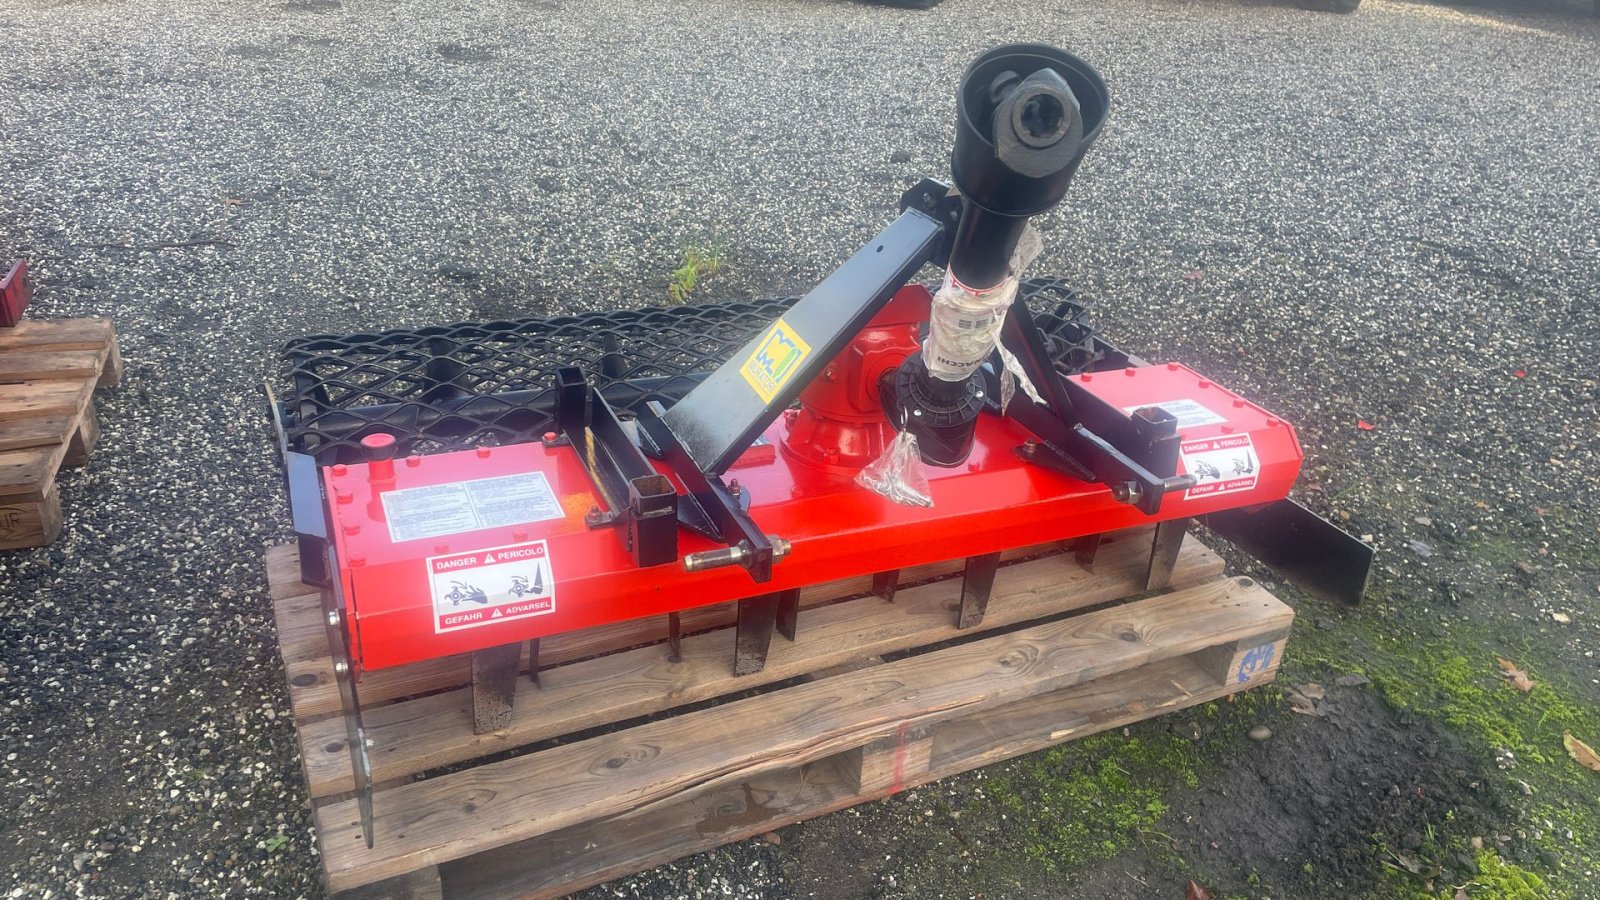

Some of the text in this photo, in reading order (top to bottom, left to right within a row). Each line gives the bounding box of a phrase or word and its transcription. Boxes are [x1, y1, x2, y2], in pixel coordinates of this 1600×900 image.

[437, 546, 544, 570] DANGER PERICOLO
[444, 601, 551, 625] GEFAHR ADVARSEL
